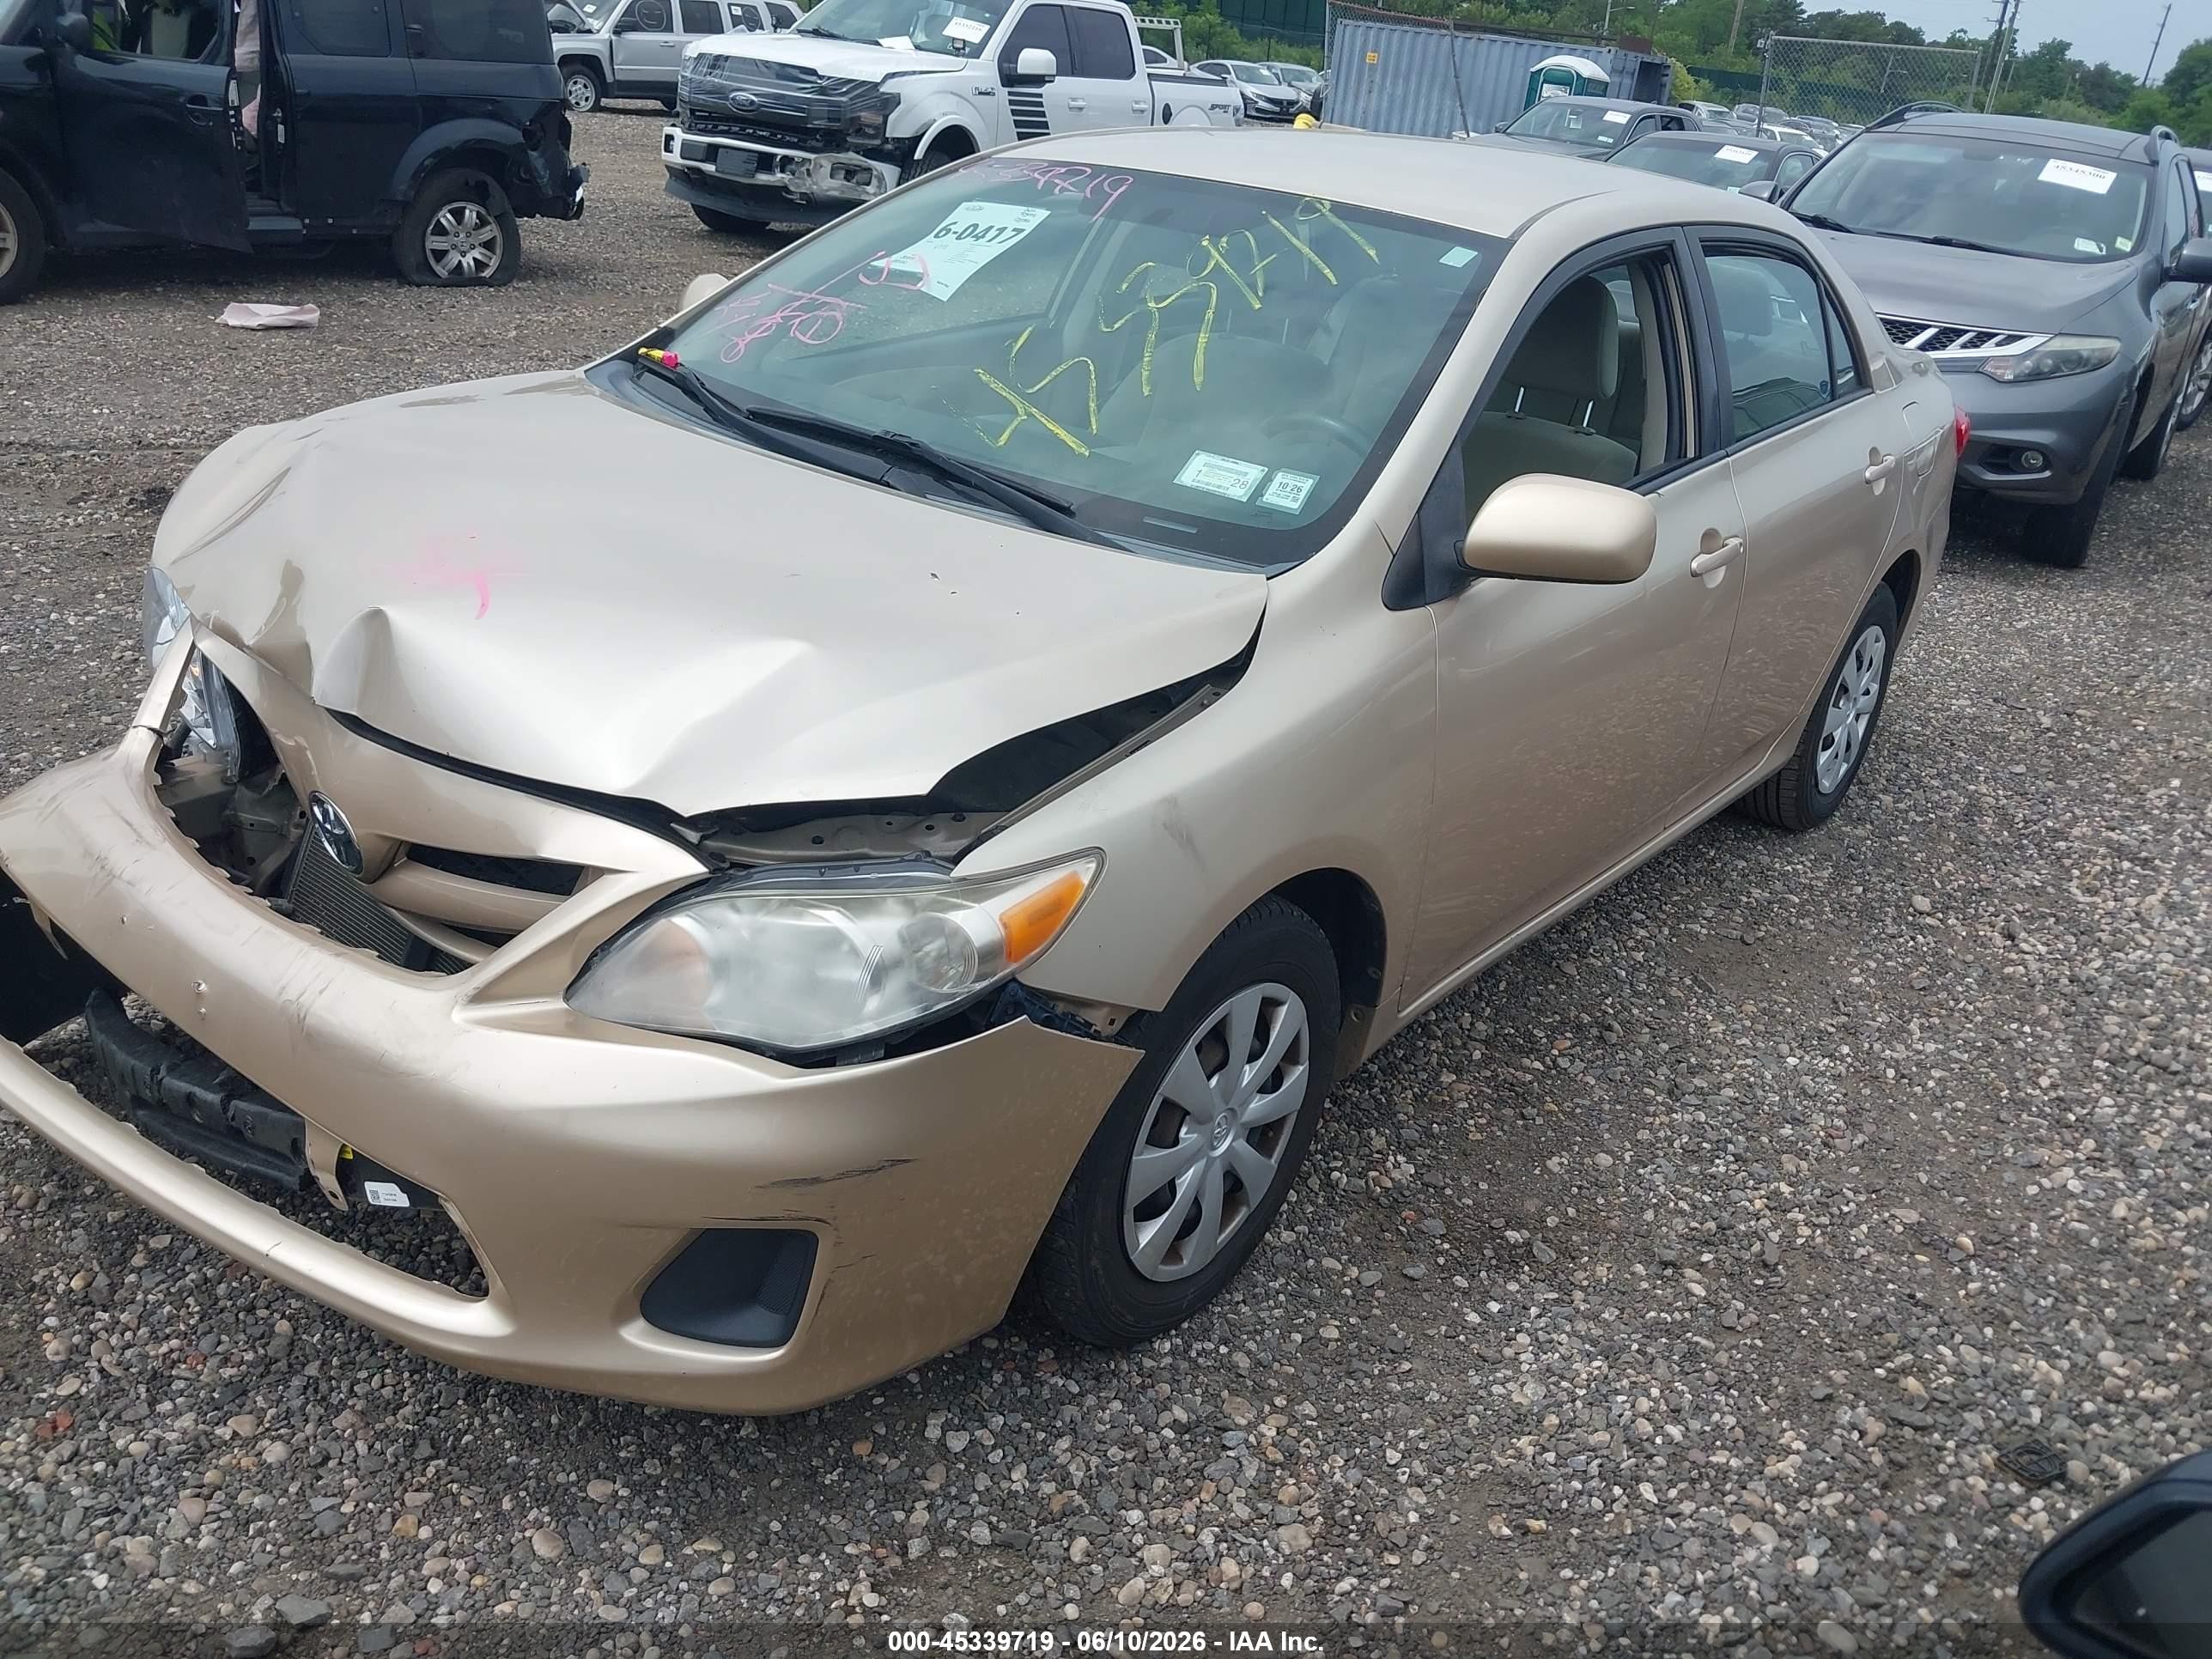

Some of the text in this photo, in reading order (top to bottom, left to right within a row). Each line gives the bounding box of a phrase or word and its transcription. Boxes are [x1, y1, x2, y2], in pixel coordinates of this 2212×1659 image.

[933, 221, 1026, 245] 6-0417
[1230, 478, 1249, 489] 28
[1277, 481, 1304, 493] 10 26
